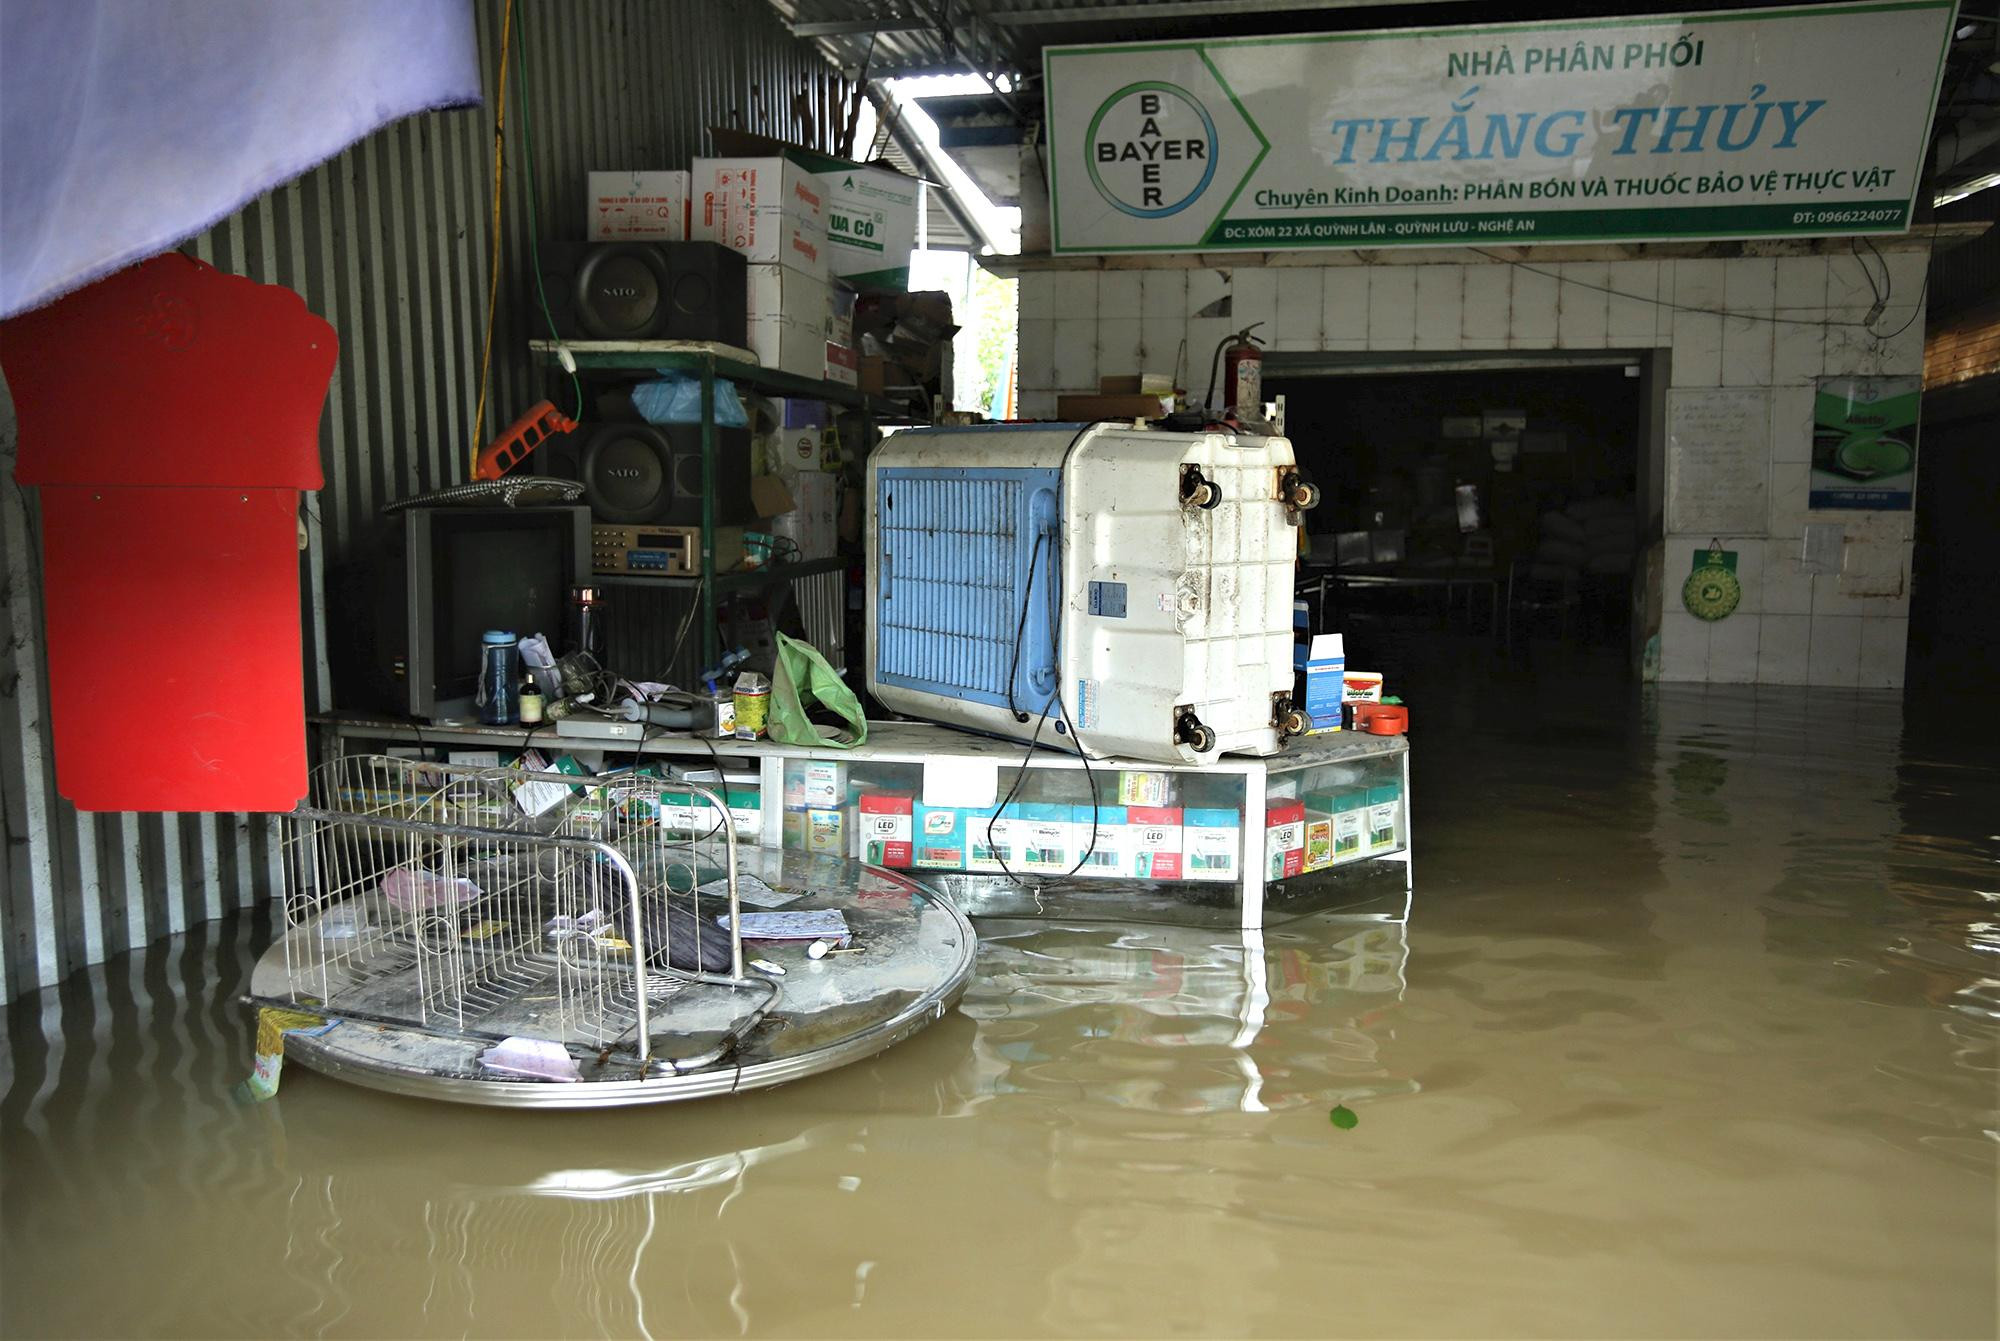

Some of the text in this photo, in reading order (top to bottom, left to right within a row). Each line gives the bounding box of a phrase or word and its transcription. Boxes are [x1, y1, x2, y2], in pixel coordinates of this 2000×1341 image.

[1447, 32, 1704, 77] NHÀ PHÂN PHỐI
[1331, 83, 1828, 166] THẮNG THỦY
[1097, 139, 1206, 163] BAYER
[1140, 94, 1164, 207] BAYER
[1254, 166, 1897, 209] Chuyên Kinh Doanh: PHÂN BÓN VÀ THUỐC BẢO VỆ THỰC VẬT
[828, 213, 850, 233] UA
[1793, 209, 1902, 224] ĐT: 0966224077
[1225, 226, 1246, 239] ĐC:
[1248, 224, 1276, 238] XÓM
[1278, 225, 1292, 237] 22
[1295, 223, 1312, 237] XÃ
[1314, 223, 1359, 237] QUỲNH
[1360, 222, 1387, 235] LÂN
[1395, 221, 1440, 236] QUỲNH
[1442, 220, 1469, 233] LƯU
[1478, 219, 1514, 234] NGHỆ
[1515, 220, 1536, 232] AN
[602, 287, 637, 298] SATO
[607, 469, 640, 479] SATO
[878, 821, 894, 830] LED
[1146, 832, 1163, 841] LED
